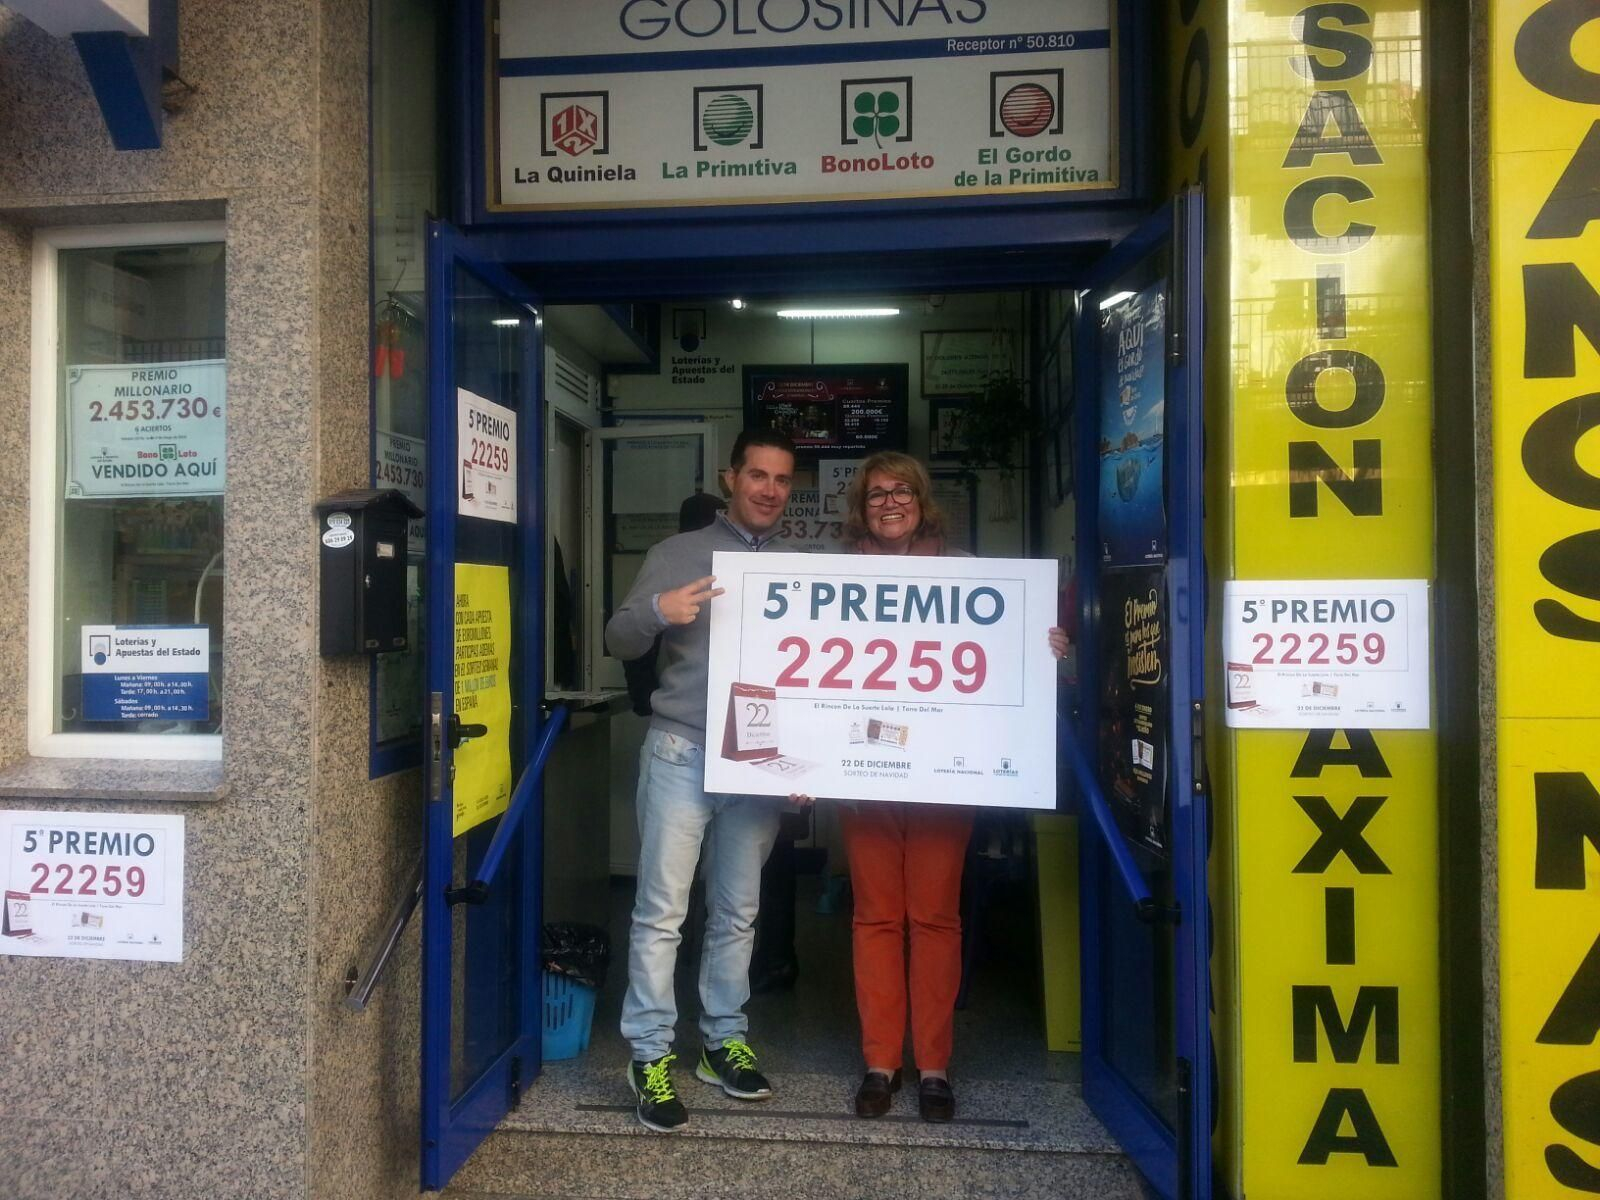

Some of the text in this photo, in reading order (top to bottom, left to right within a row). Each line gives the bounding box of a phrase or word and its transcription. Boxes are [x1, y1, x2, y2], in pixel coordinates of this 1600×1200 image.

[947, 38, 1005, 54] Receptor
[1026, 34, 1076, 49] 50.810
[821, 152, 934, 175] BonoLoto
[977, 145, 1072, 166] El Gordo
[514, 163, 636, 185] La Quiniela
[662, 157, 797, 180] La Primitiva
[953, 164, 1099, 187] de la Primitiva
[671, 355, 721, 367] Loterías y
[671, 365, 735, 376] Apuestas del
[131, 369, 178, 382] PREMIO
[671, 375, 706, 385] Estado
[114, 384, 192, 398] MILLONARIO
[89, 397, 222, 422] 2.453.730 €
[476, 411, 510, 442] PREMIO
[389, 438, 411, 452] PREMIO
[471, 438, 509, 473] 22259
[92, 458, 217, 480] VENDIDO AQUÍ
[376, 460, 424, 489] 2.453.730
[810, 582, 1005, 626] PREMIO
[1272, 599, 1395, 624] PREMIO
[115, 637, 157, 648] Loterías y
[115, 647, 201, 658] Apuestas del Estado
[1252, 632, 1385, 665] 22259
[775, 636, 988, 694] 22259
[1233, 674, 1251, 689] 22
[746, 702, 771, 727] 22
[841, 759, 912, 769] 22 DE DICIEMBRE
[49, 830, 155, 857] PREMIO
[29, 862, 146, 897] 22259
[13, 902, 29, 918] 22
